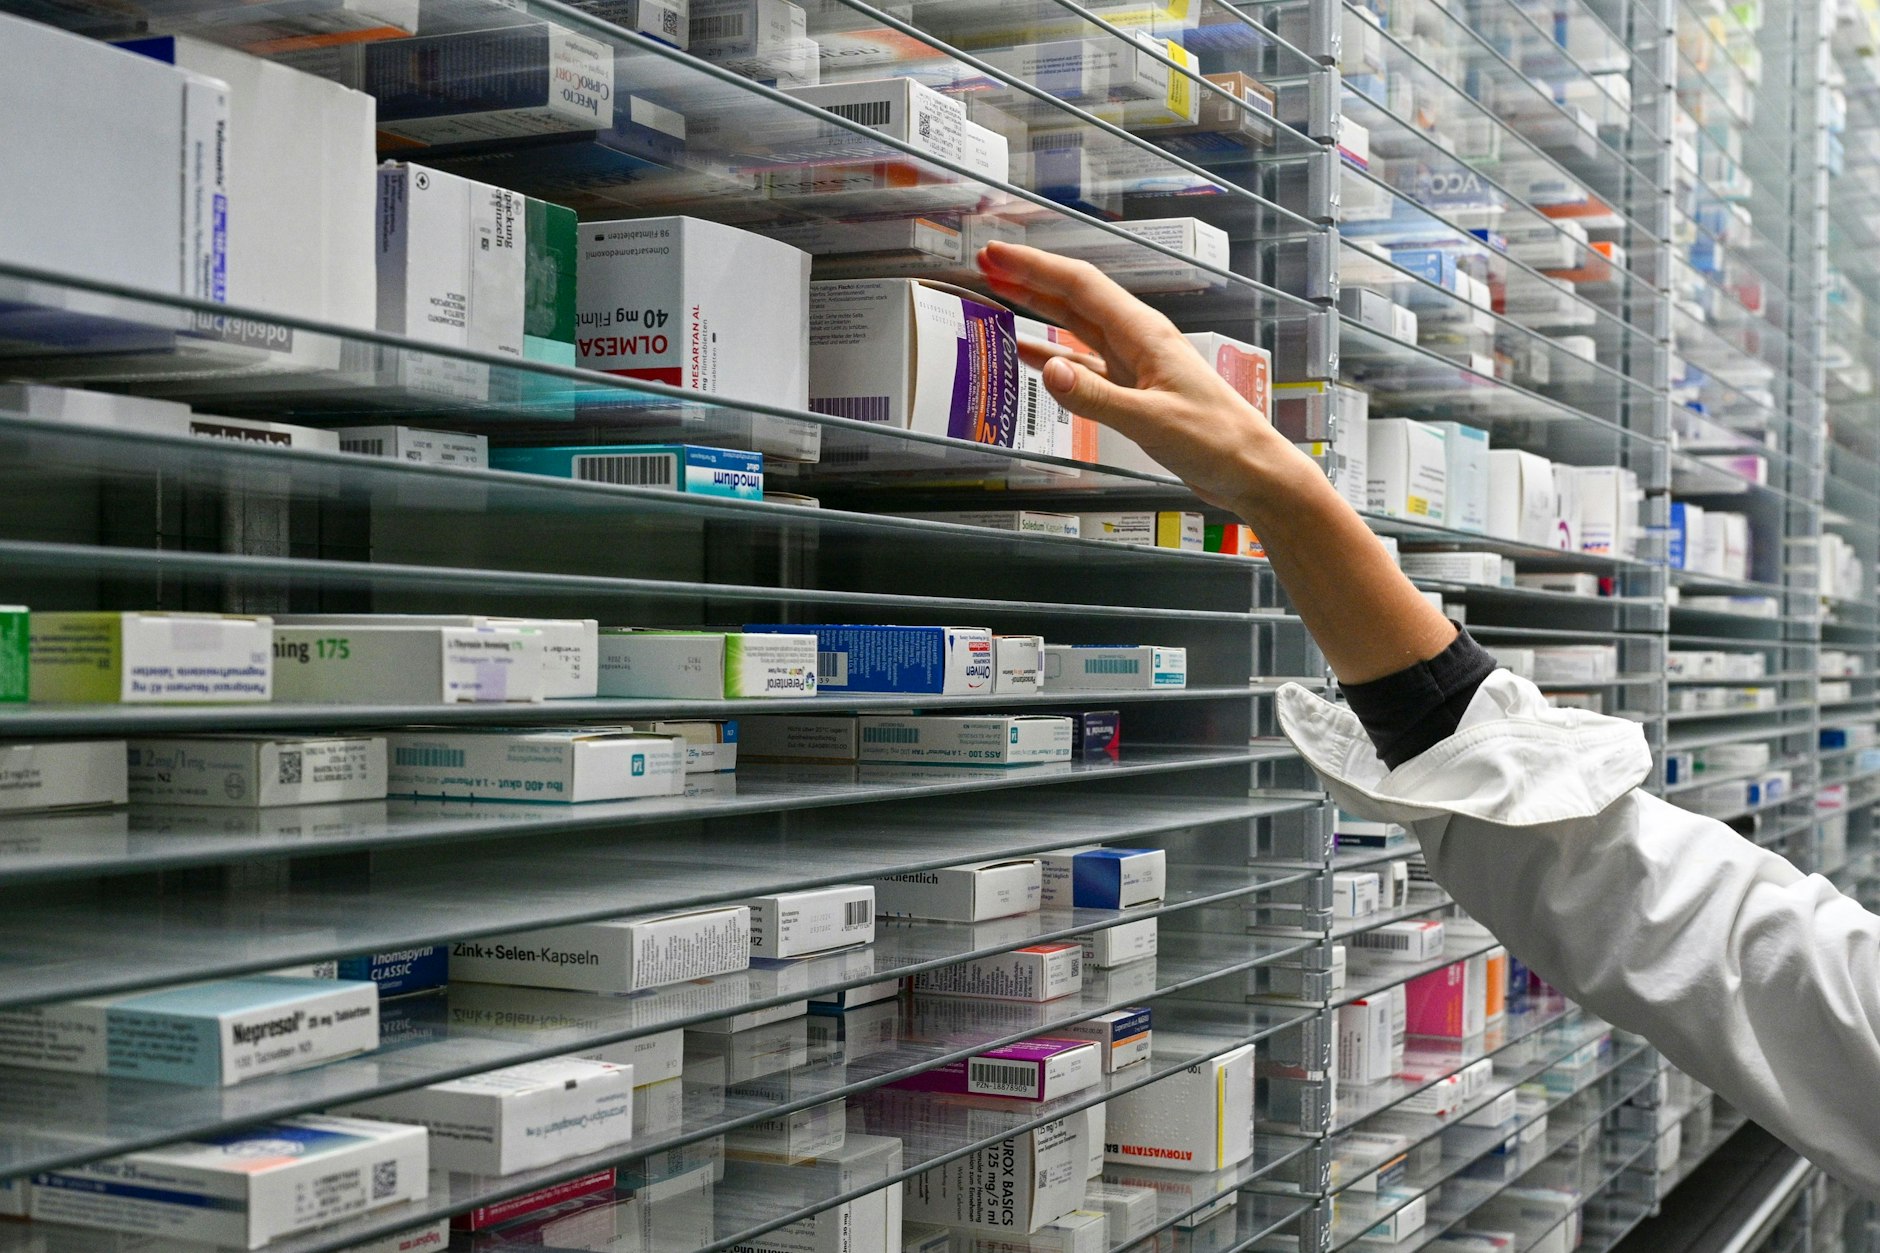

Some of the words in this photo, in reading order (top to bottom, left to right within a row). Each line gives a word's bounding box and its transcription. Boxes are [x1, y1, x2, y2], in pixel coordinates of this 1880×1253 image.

[608, 230, 658, 240] Filmtabletten
[616, 308, 639, 323] mg
[644, 309, 668, 328] 40
[989, 317, 997, 418] Schwangerschaft
[982, 422, 996, 444] 2
[746, 463, 760, 472] akut
[712, 472, 760, 490] Imodium
[1022, 519, 1045, 531] Soledum
[1064, 526, 1078, 535] forte
[317, 638, 350, 659] 175
[767, 678, 804, 691] Perenterol
[968, 750, 983, 758] 100
[985, 750, 1001, 758] ASS
[499, 779, 521, 790] akut
[523, 779, 544, 791] 400
[546, 781, 563, 792] Ibu
[371, 962, 412, 981] CLASSIC
[988, 1147, 999, 1168] 125
[1122, 1145, 1193, 1162] ATORVASTATIN
[985, 1173, 999, 1206] mg/5
[1002, 1180, 1014, 1226] BASICS
[988, 1211, 999, 1225] ml
